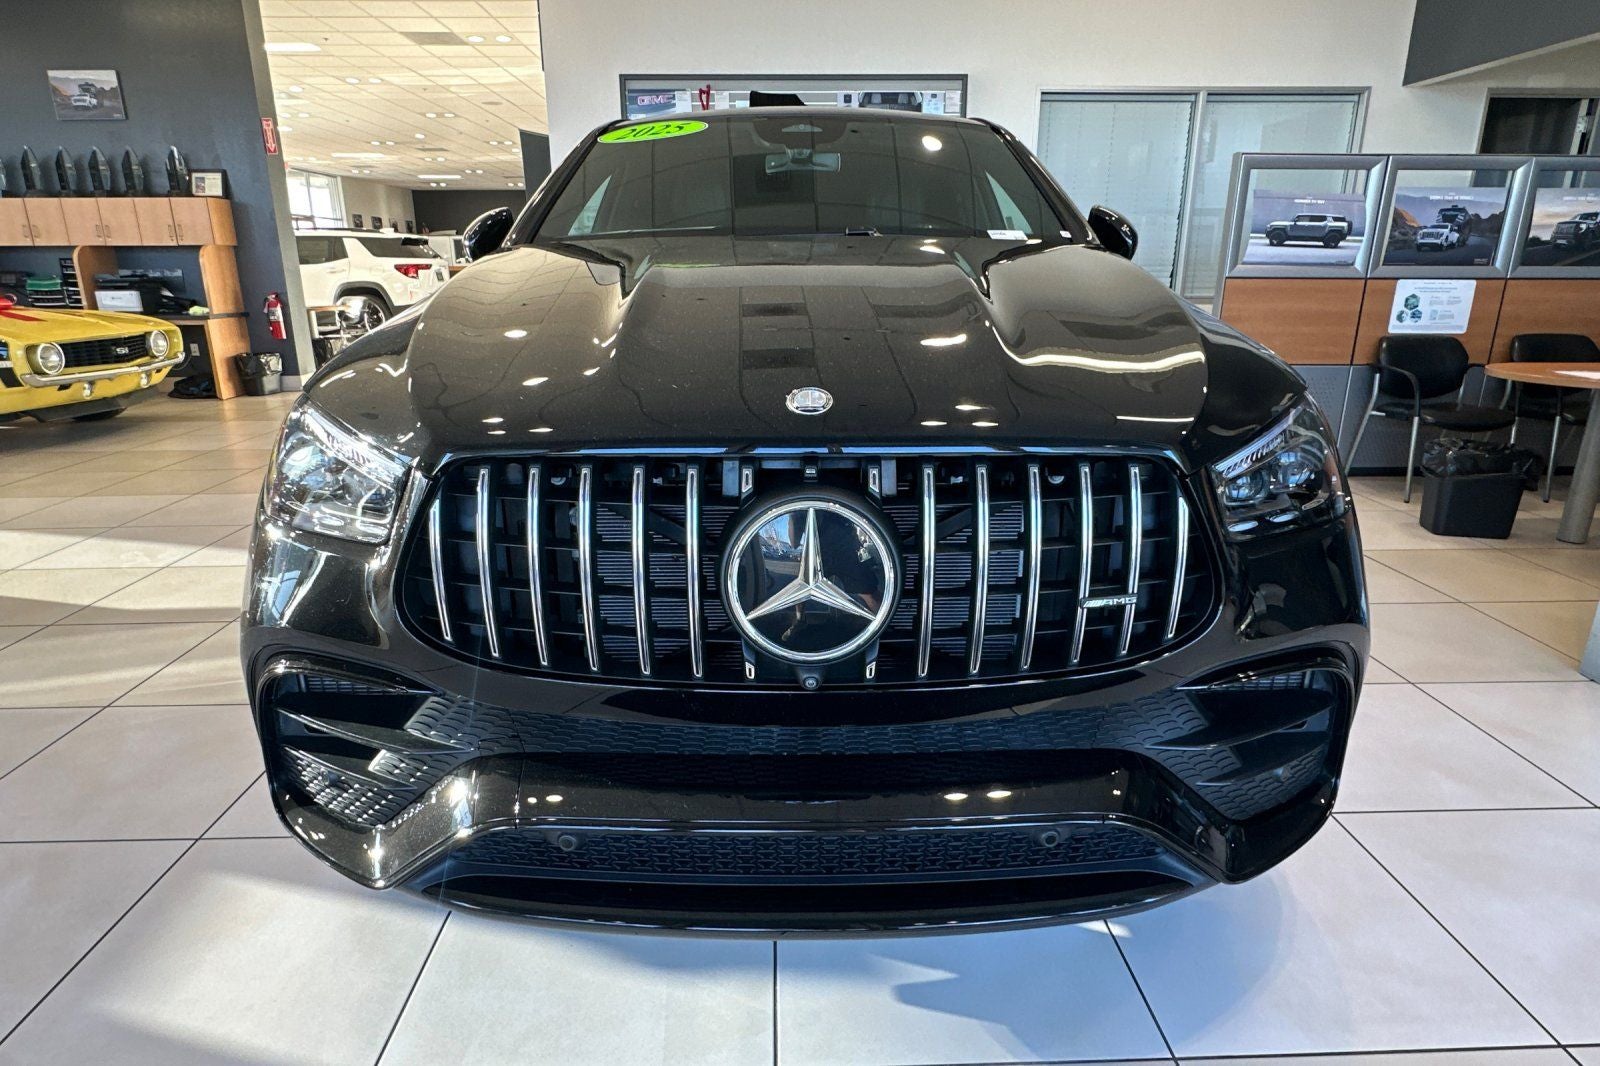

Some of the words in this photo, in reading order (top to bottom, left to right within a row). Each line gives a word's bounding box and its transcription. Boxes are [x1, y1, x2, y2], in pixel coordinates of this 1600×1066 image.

[637, 95, 674, 106] GMC
[612, 122, 691, 141] 2025
[1099, 596, 1138, 607] AMG
